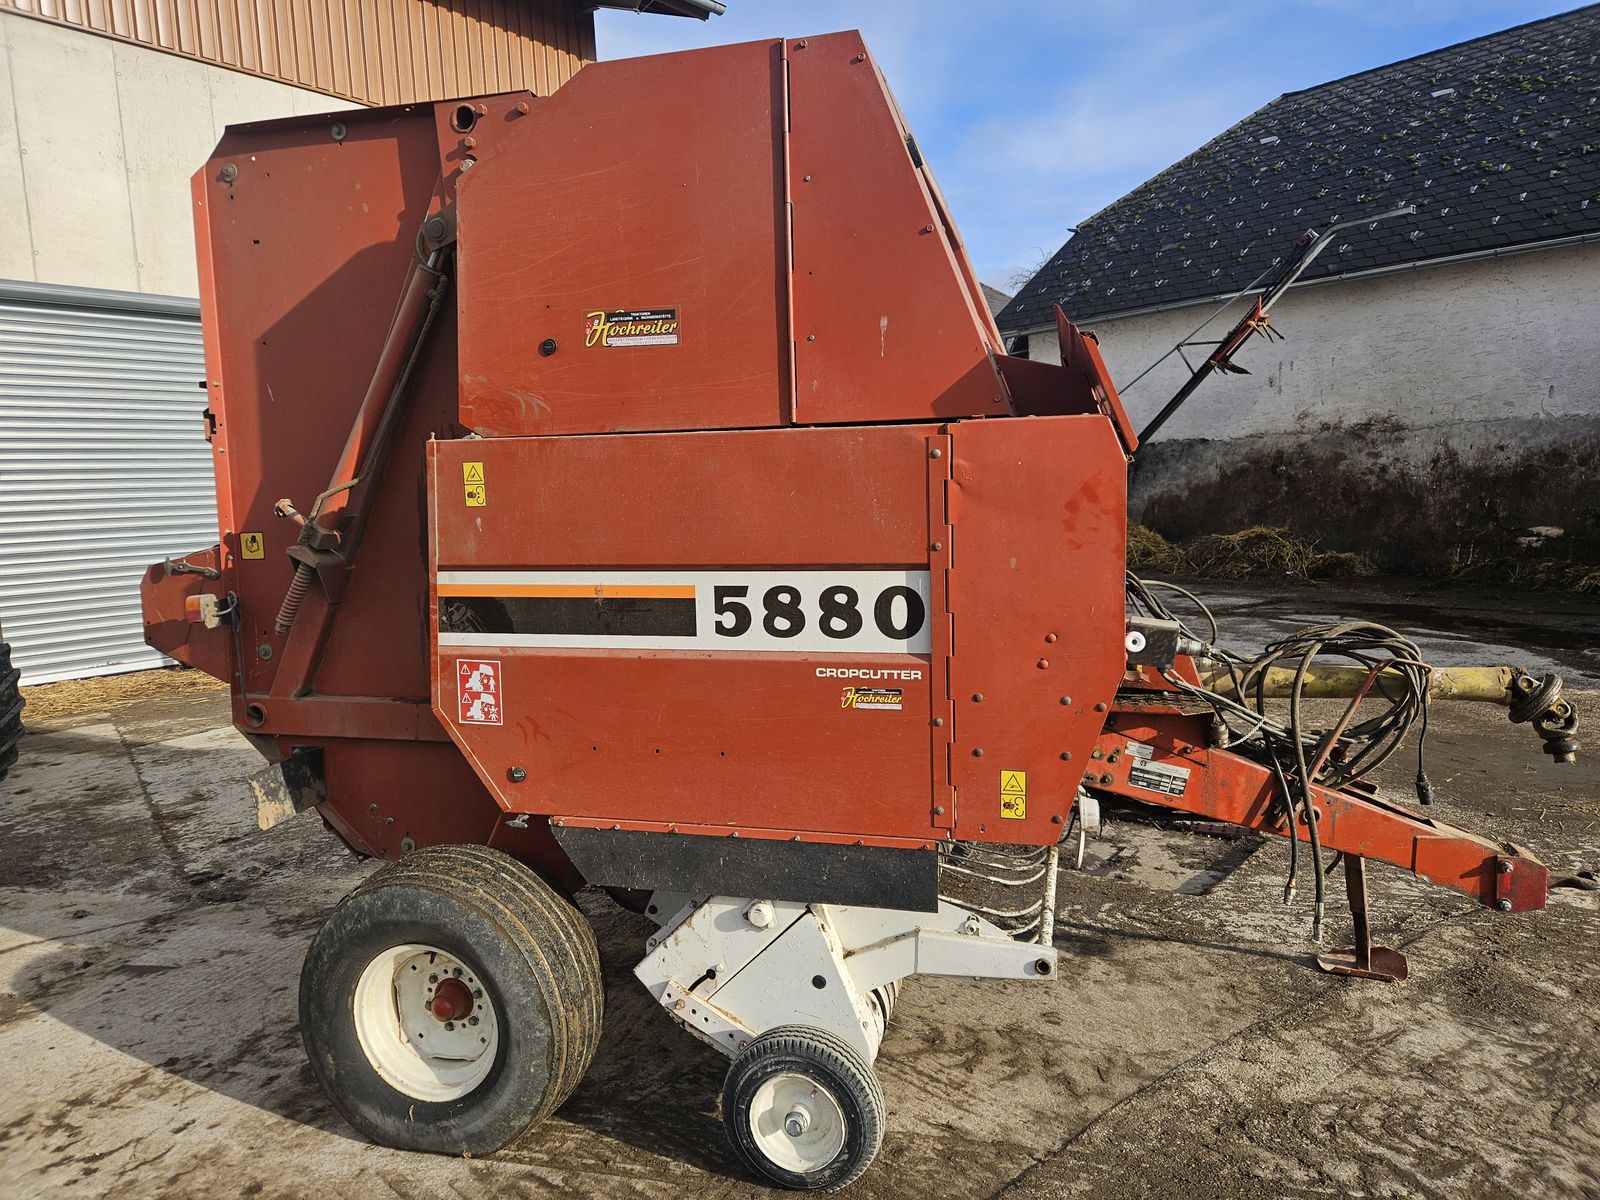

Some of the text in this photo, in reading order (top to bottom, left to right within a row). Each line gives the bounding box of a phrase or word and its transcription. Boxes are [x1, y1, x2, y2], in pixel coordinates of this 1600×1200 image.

[585, 310, 678, 347] Hochreiter
[713, 585, 926, 640] 5880
[815, 667, 922, 680] CROPCUTTER
[841, 686, 902, 709] Hochreiter
